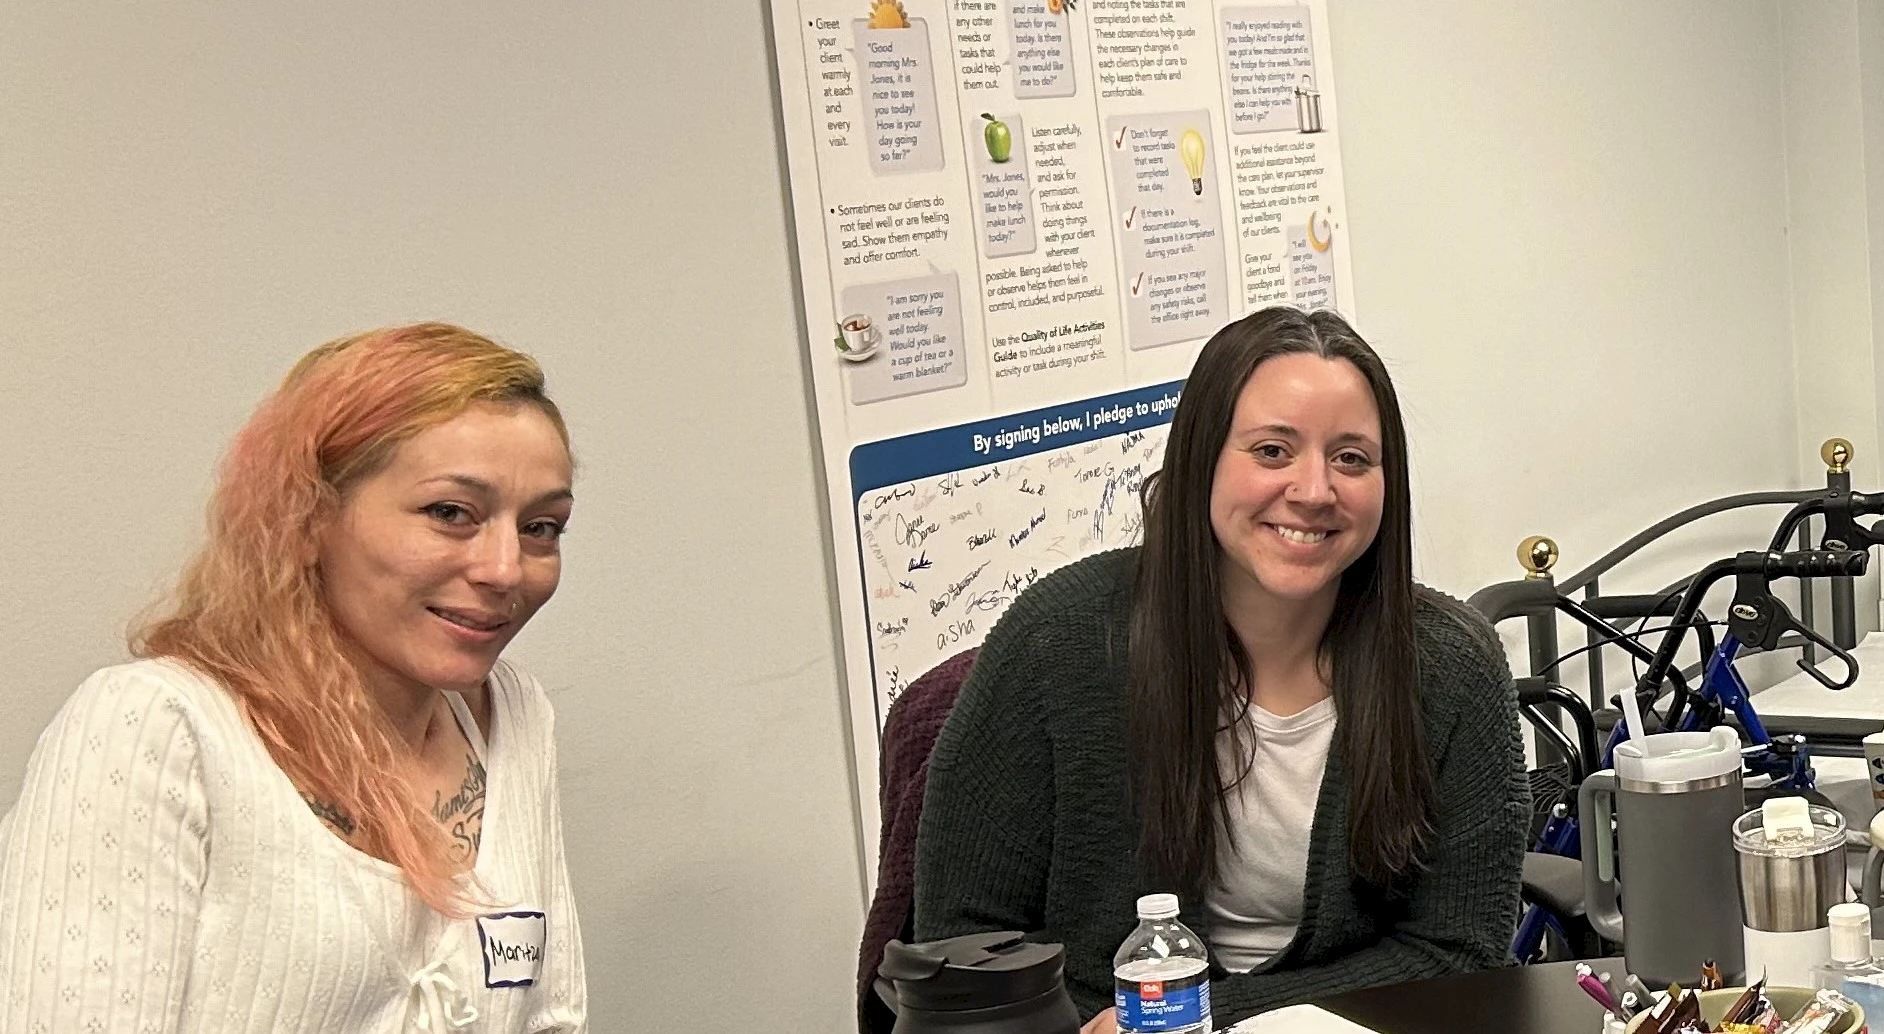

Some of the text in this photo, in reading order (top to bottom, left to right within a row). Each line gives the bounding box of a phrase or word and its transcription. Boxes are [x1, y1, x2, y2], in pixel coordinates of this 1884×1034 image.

[816, 18, 840, 30] Greet
[817, 37, 836, 49] your
[962, 62, 1001, 76] could help
[823, 85, 853, 97] at each
[963, 80, 984, 90] them
[826, 102, 841, 113] and
[827, 121, 850, 132] every
[1031, 127, 1051, 137] Listen
[1033, 140, 1076, 154] adjust when
[1037, 169, 1077, 182] and ask for
[838, 195, 945, 216] Sometimes our clients do
[1041, 200, 1084, 213] Think about
[840, 212, 950, 233] not feel well or are feeling
[1043, 215, 1088, 228] doing things
[862, 234, 886, 247] Show
[888, 231, 910, 244] them
[912, 228, 948, 243] empathy
[1045, 229, 1095, 244] with your client
[843, 253, 861, 266] and
[863, 250, 883, 263] offer
[1020, 266, 1040, 278] Being
[1042, 263, 1062, 274] asked
[1063, 261, 1071, 270] to
[1072, 258, 1088, 271] help
[987, 274, 1088, 297] or observe helps them feel in
[1052, 291, 1065, 303] and
[992, 320, 1105, 347] Use the Quality of Life Activities
[993, 334, 1102, 362] Guide to include a meaningful
[995, 365, 1022, 377] activity
[1023, 364, 1031, 373] or
[1032, 360, 1047, 372] task
[1048, 356, 1072, 369] during
[1073, 354, 1089, 366] your
[973, 391, 1182, 455] By signing below, I pledge to uphol
[1140, 999, 1167, 1008] Natural
[1141, 1004, 1184, 1015] Spring Water
